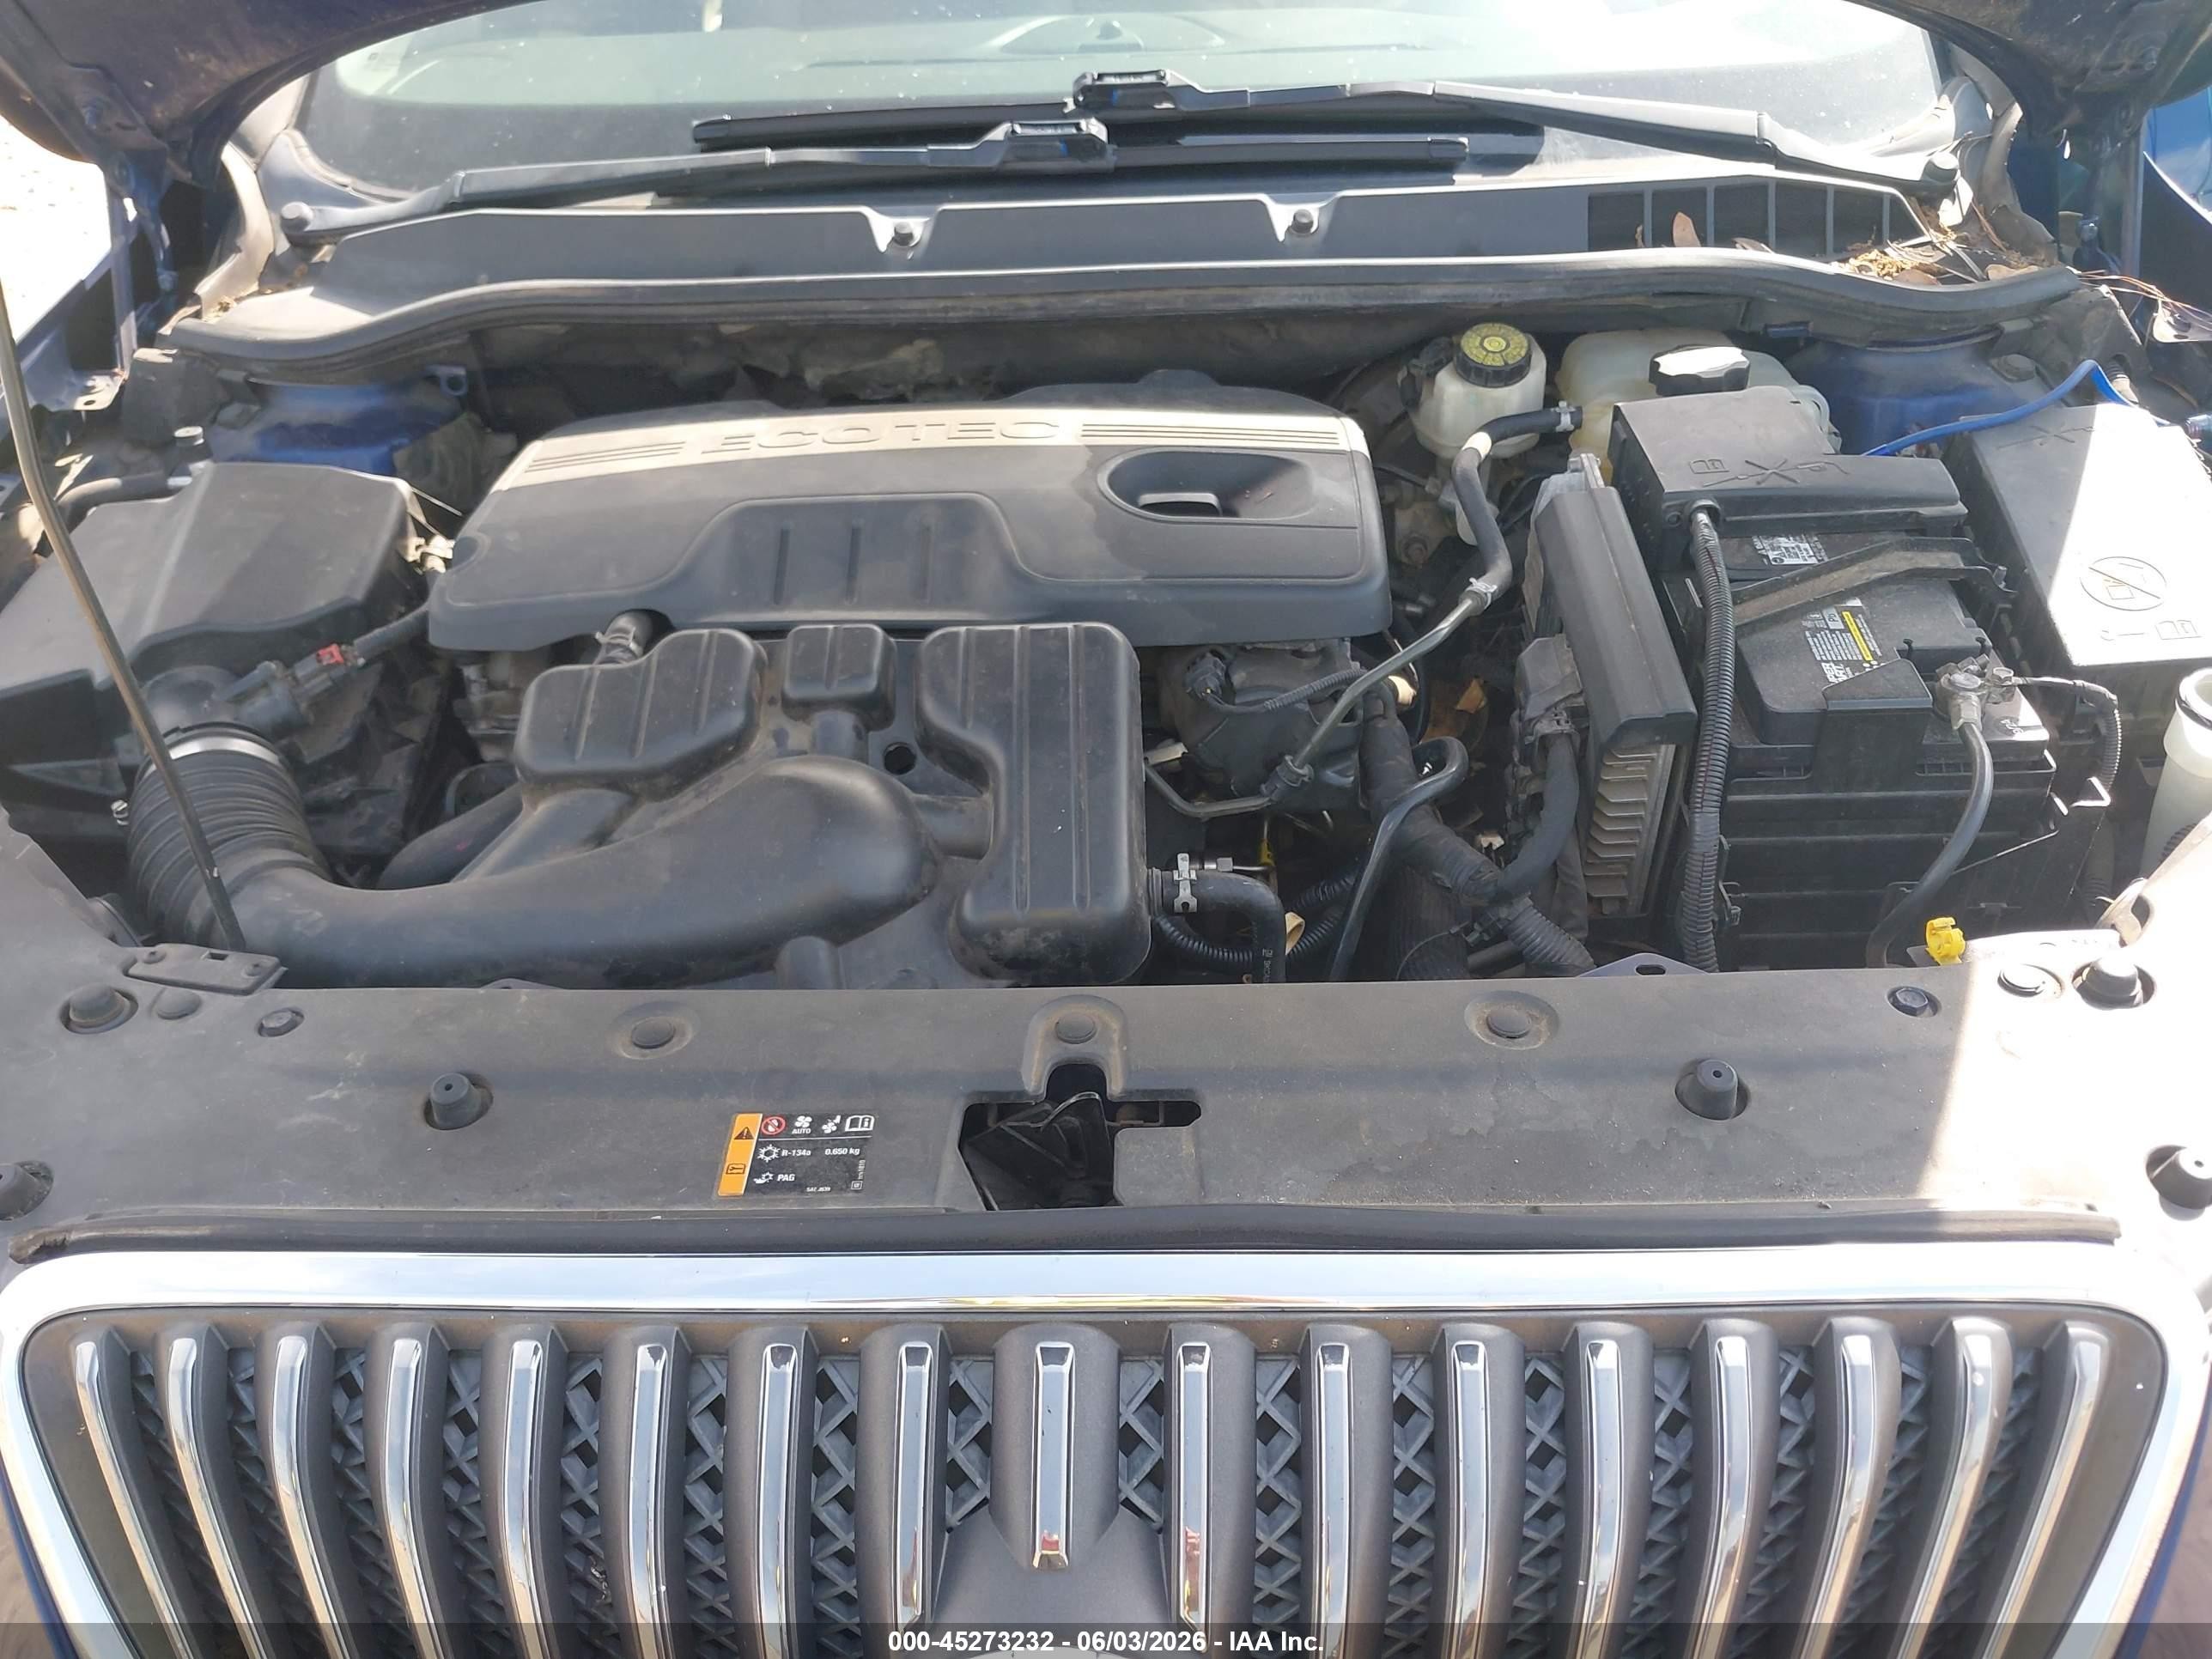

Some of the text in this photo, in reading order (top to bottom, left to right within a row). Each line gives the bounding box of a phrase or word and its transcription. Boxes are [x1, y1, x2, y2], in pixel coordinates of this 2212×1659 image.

[701, 421, 1060, 454] ECOTEC
[849, 1147, 860, 1156] kg
[777, 1173, 795, 1182] PAG
